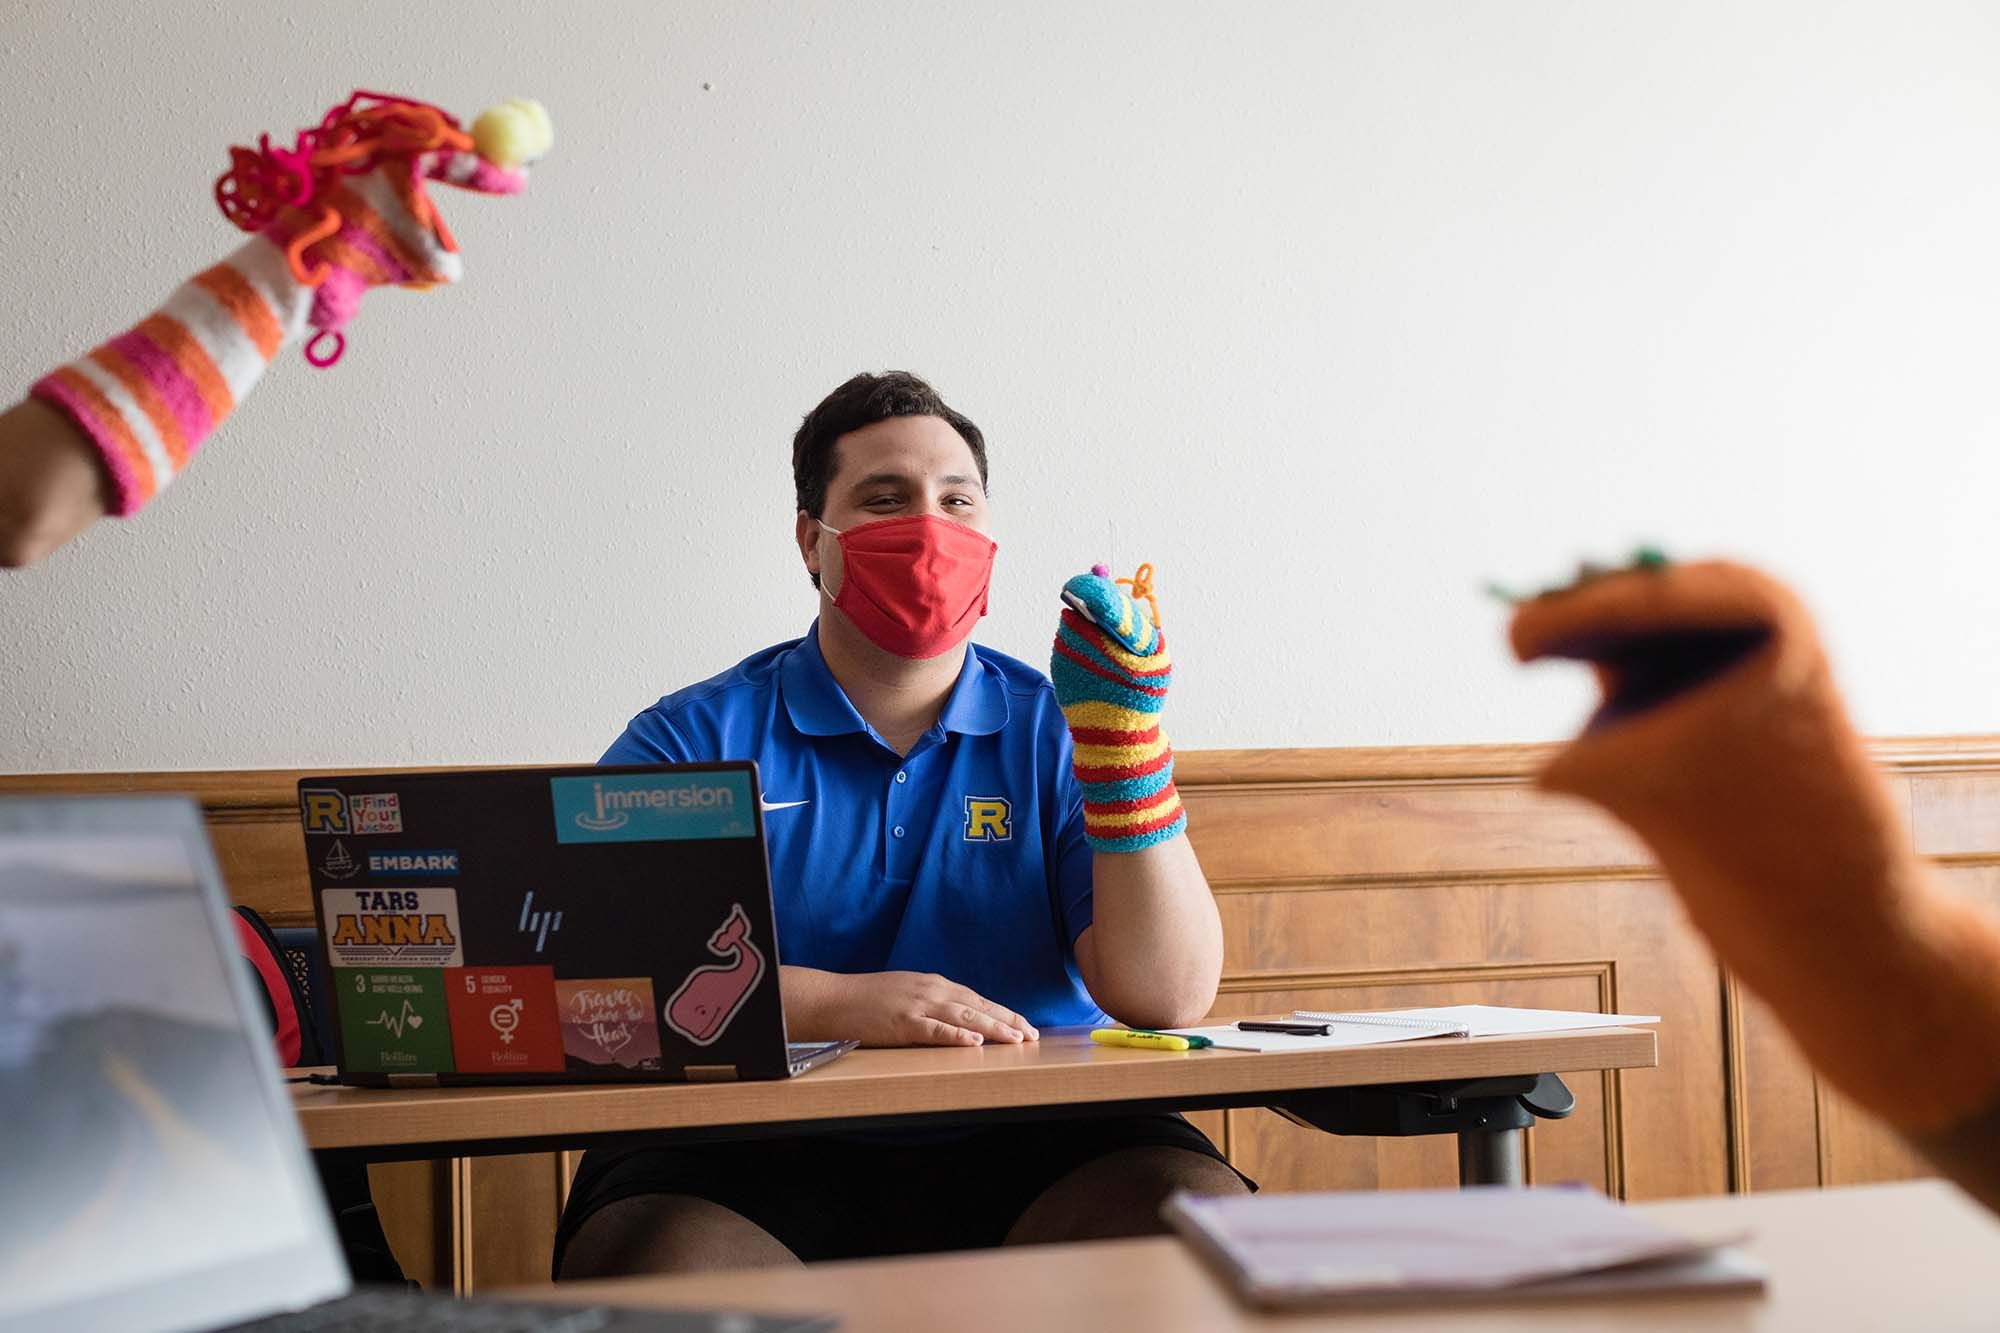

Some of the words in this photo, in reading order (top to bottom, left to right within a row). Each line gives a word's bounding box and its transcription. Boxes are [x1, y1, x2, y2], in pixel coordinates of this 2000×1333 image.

[352, 793, 397, 808] #Find
[594, 783, 734, 820] immersion
[302, 789, 351, 834] R
[355, 810, 399, 822] Your
[964, 796, 1012, 841] R
[369, 856, 457, 870] EMBARK
[356, 891, 419, 911] TARS
[333, 914, 455, 946] ANNA
[355, 974, 366, 993] 3
[465, 975, 476, 993] 5
